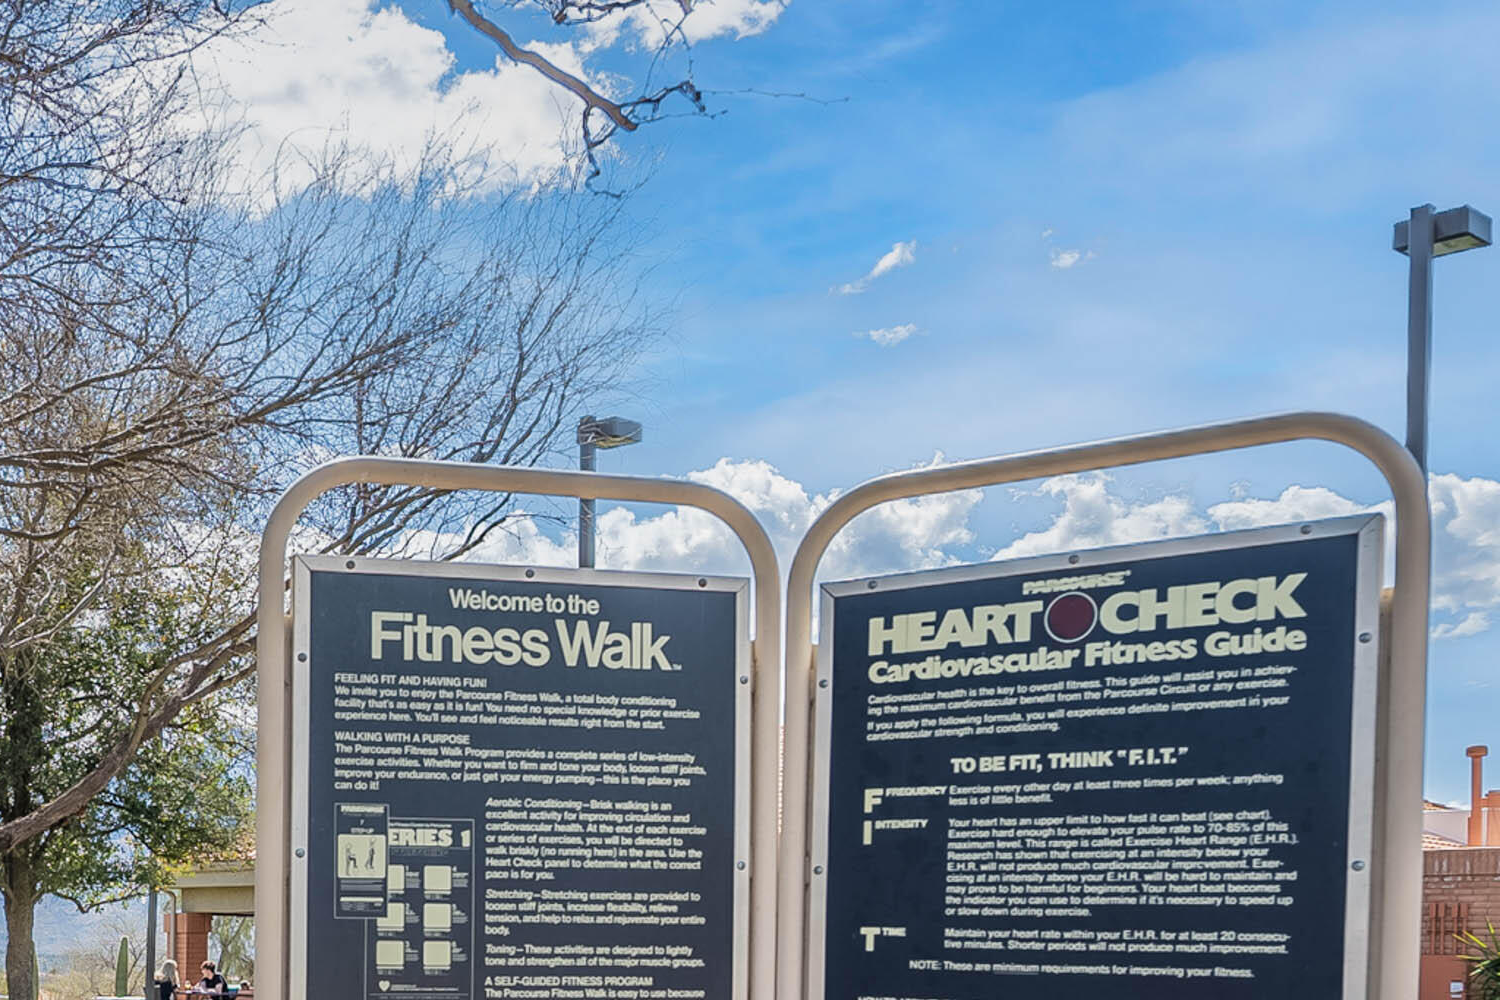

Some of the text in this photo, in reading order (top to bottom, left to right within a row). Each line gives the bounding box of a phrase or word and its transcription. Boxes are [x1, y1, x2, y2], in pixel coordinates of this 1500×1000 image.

[1022, 572, 1126, 595] PARCOURSE
[448, 587, 600, 615] Welcome to the
[868, 573, 1308, 656] HEART CHECK
[371, 610, 675, 671] Fitness Walk
[867, 625, 1307, 684] Cardiovascular Fitness Guide
[333, 672, 487, 688] FEELING FIT AND HAVING FUN!
[334, 684, 677, 708] We invite you to enjoy the Parcourse Fitness Walk, a total body conditioning
[333, 730, 470, 745] WALKING WITH A PURPOSE
[949, 756, 976, 773] TO
[978, 755, 1006, 772] BE
[1008, 753, 1043, 773] FIT,
[1046, 749, 1114, 769] THINK
[863, 788, 884, 814] F
[885, 785, 948, 797] FREQUENCY
[874, 818, 928, 829] INTENSITY
[388, 828, 471, 847] ERIES 1
[859, 926, 906, 952] T TIME
[483, 975, 653, 986] A SELF-GUIDED FITNESS PROGRAM
